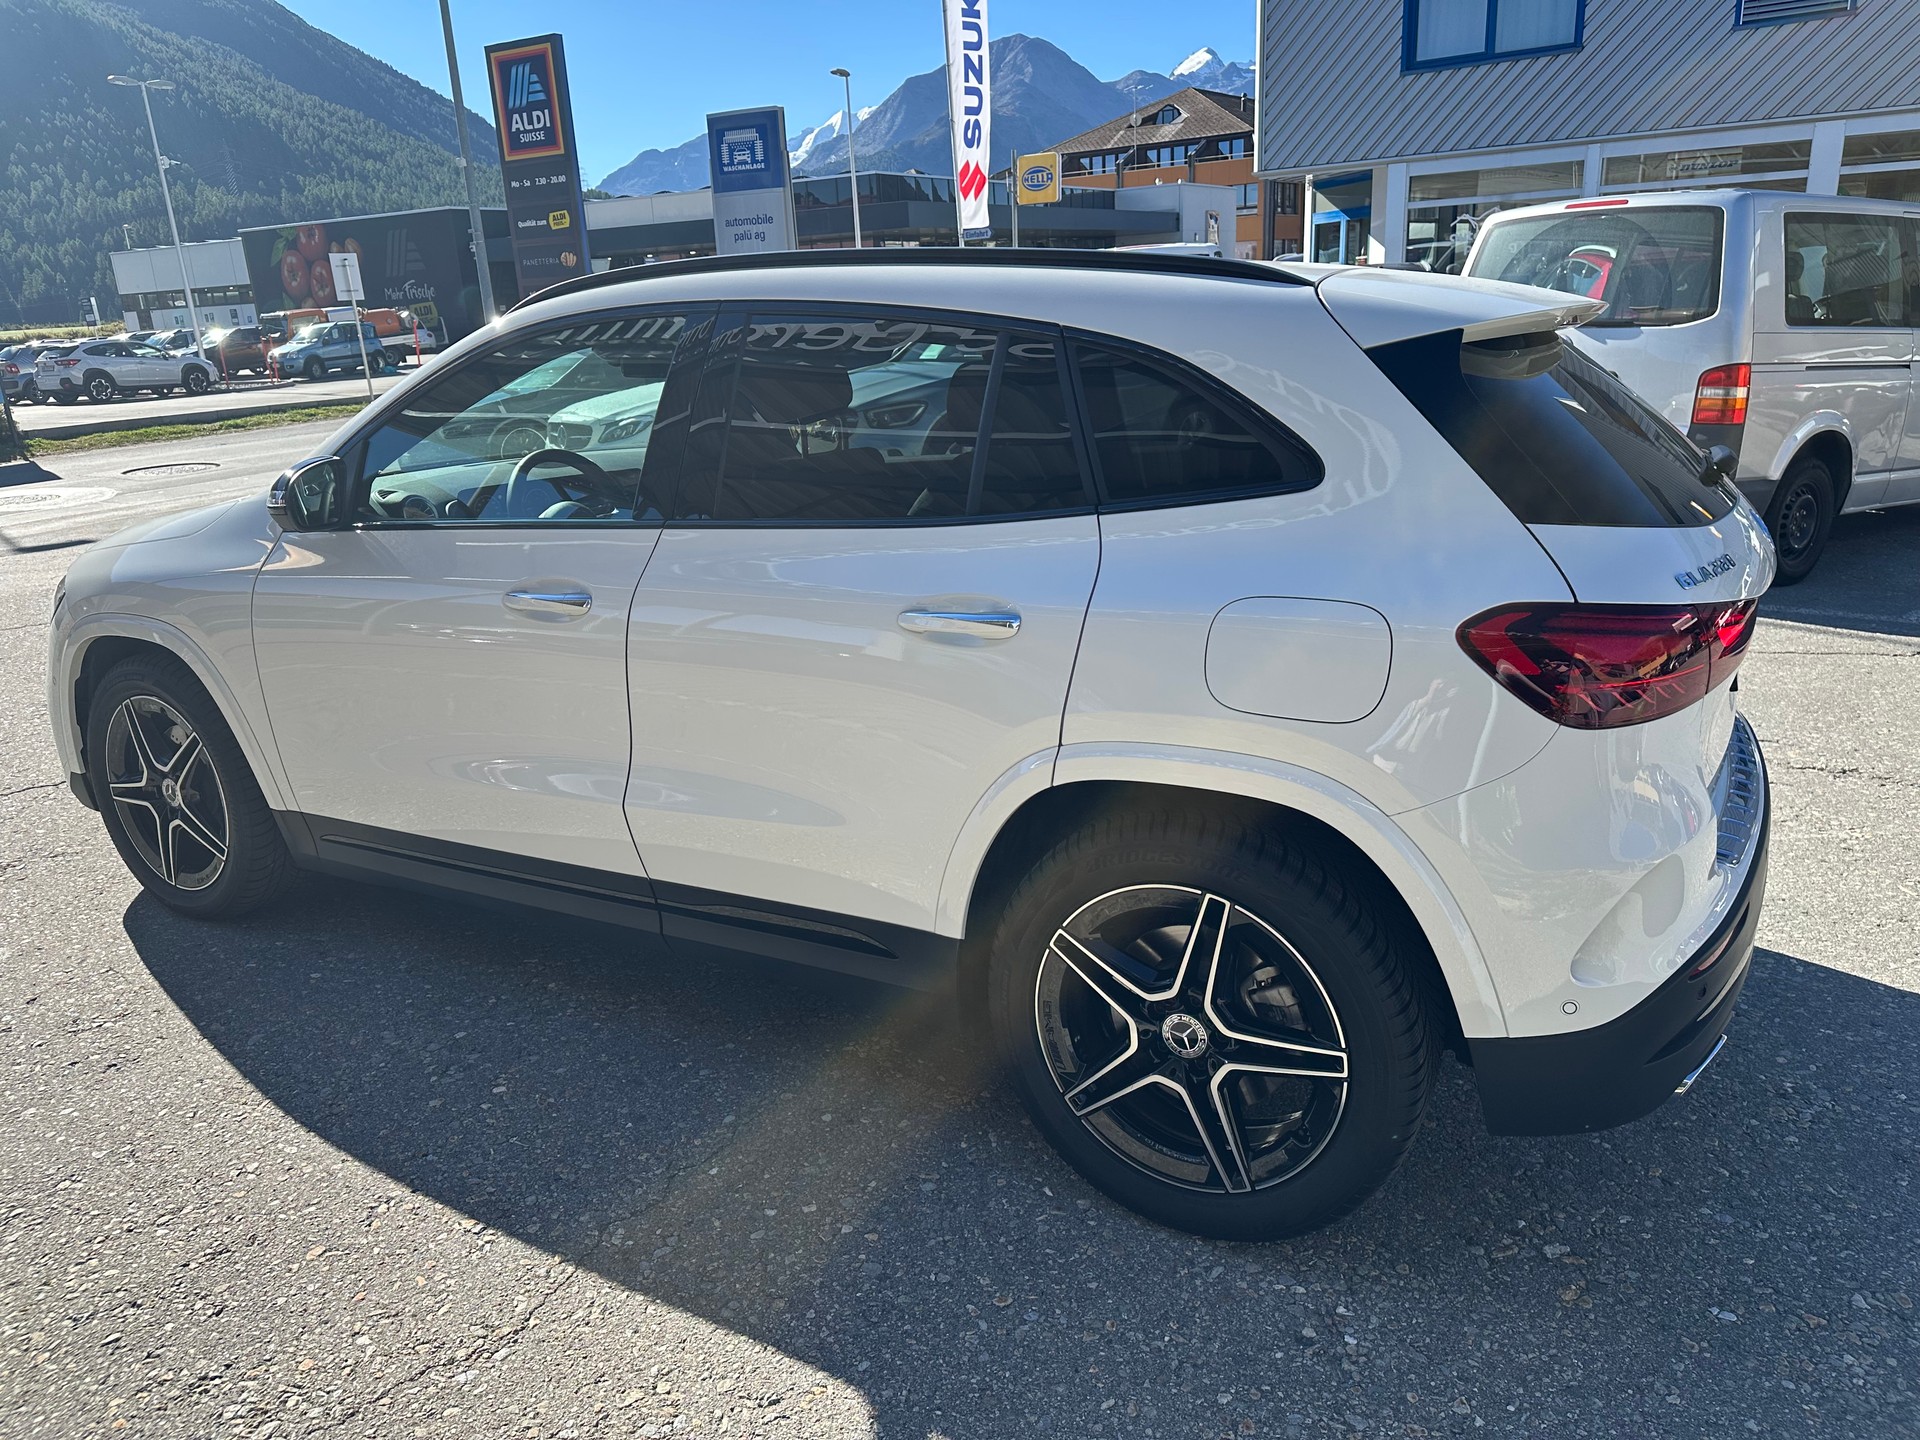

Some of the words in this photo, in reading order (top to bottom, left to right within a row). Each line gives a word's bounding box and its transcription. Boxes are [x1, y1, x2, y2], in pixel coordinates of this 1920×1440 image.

[511, 108, 551, 132] ALDI
[519, 130, 546, 143] SUISSE
[722, 162, 766, 172] WASCHANLAGE
[550, 174, 567, 184] 20.00
[1023, 171, 1054, 185] HELLA
[552, 211, 567, 222] ALDI
[725, 213, 774, 228] automobile
[734, 229, 753, 244] palü
[754, 230, 766, 243] ag
[965, 229, 989, 239] Einfahrt
[522, 257, 560, 267] PANETTERIA
[384, 287, 404, 301] Mehr
[402, 279, 436, 301] Frische
[414, 304, 433, 316] ALDI
